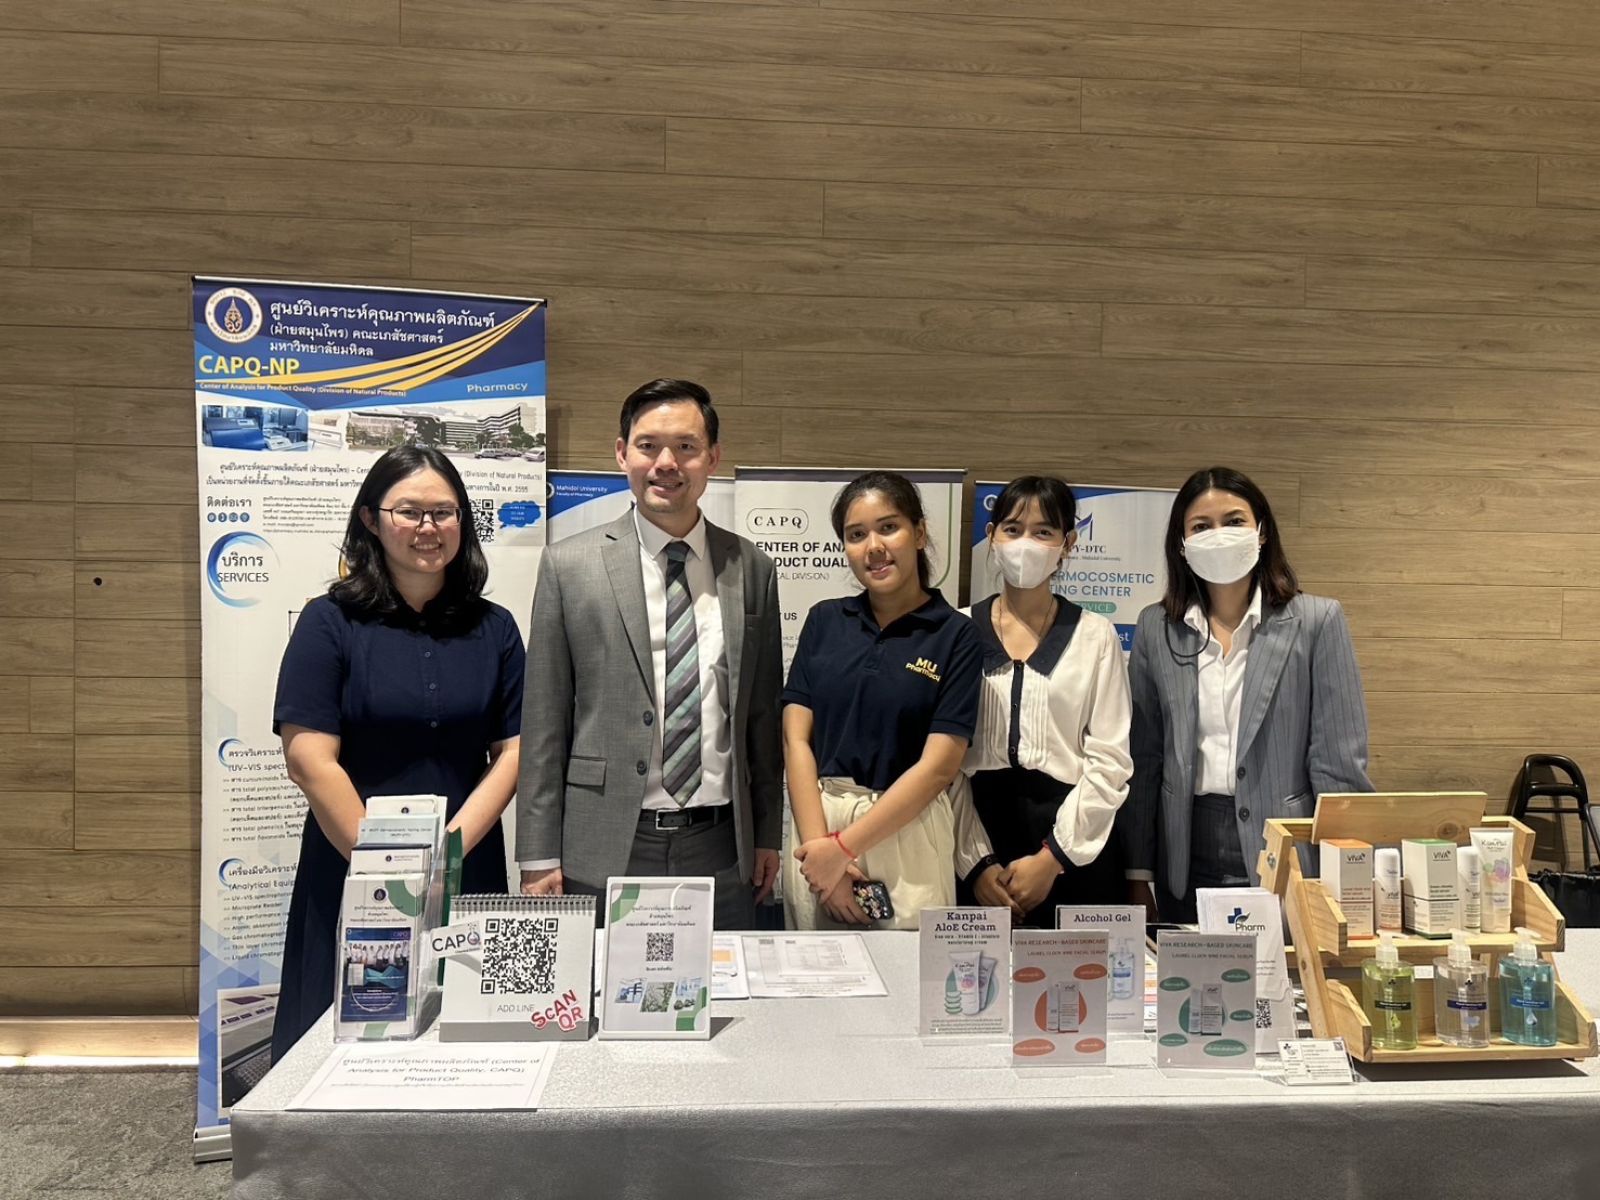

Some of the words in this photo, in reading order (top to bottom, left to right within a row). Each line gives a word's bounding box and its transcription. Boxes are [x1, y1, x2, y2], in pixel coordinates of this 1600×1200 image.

[270, 298, 495, 328] ศูนย์วิเคราะห์คุณภาพผลิตภัณฑ์
[270, 322, 349, 342] (ฝ่ายสมุนไพร)
[352, 327, 444, 345] คณะเภสัชศาสตร์
[270, 341, 374, 357] มหาวิทยาลัยมหิดล
[199, 355, 301, 377] CAPQ-NP
[230, 383, 256, 391] Analysis
[466, 382, 529, 394] Pharmacy
[556, 484, 578, 492] Mahidol
[579, 485, 608, 494] University
[207, 496, 252, 508] ติดต่อเรา
[754, 516, 803, 529] CAPQ
[802, 541, 820, 552] OF
[222, 551, 264, 567] บริการ
[812, 557, 848, 568] QUAL
[218, 572, 270, 583] SERVICES
[1081, 586, 1131, 597] CENTER
[784, 612, 798, 621] US
[915, 656, 939, 674] MU
[947, 911, 988, 924] Kanpai
[1074, 913, 1113, 923] Alcohol
[1115, 913, 1132, 923] Gel
[935, 923, 960, 932] AloE
[961, 923, 996, 932] Cream
[1235, 922, 1266, 933] Pharm
[531, 989, 577, 1028] SCAN
[558, 1006, 584, 1032] QR
